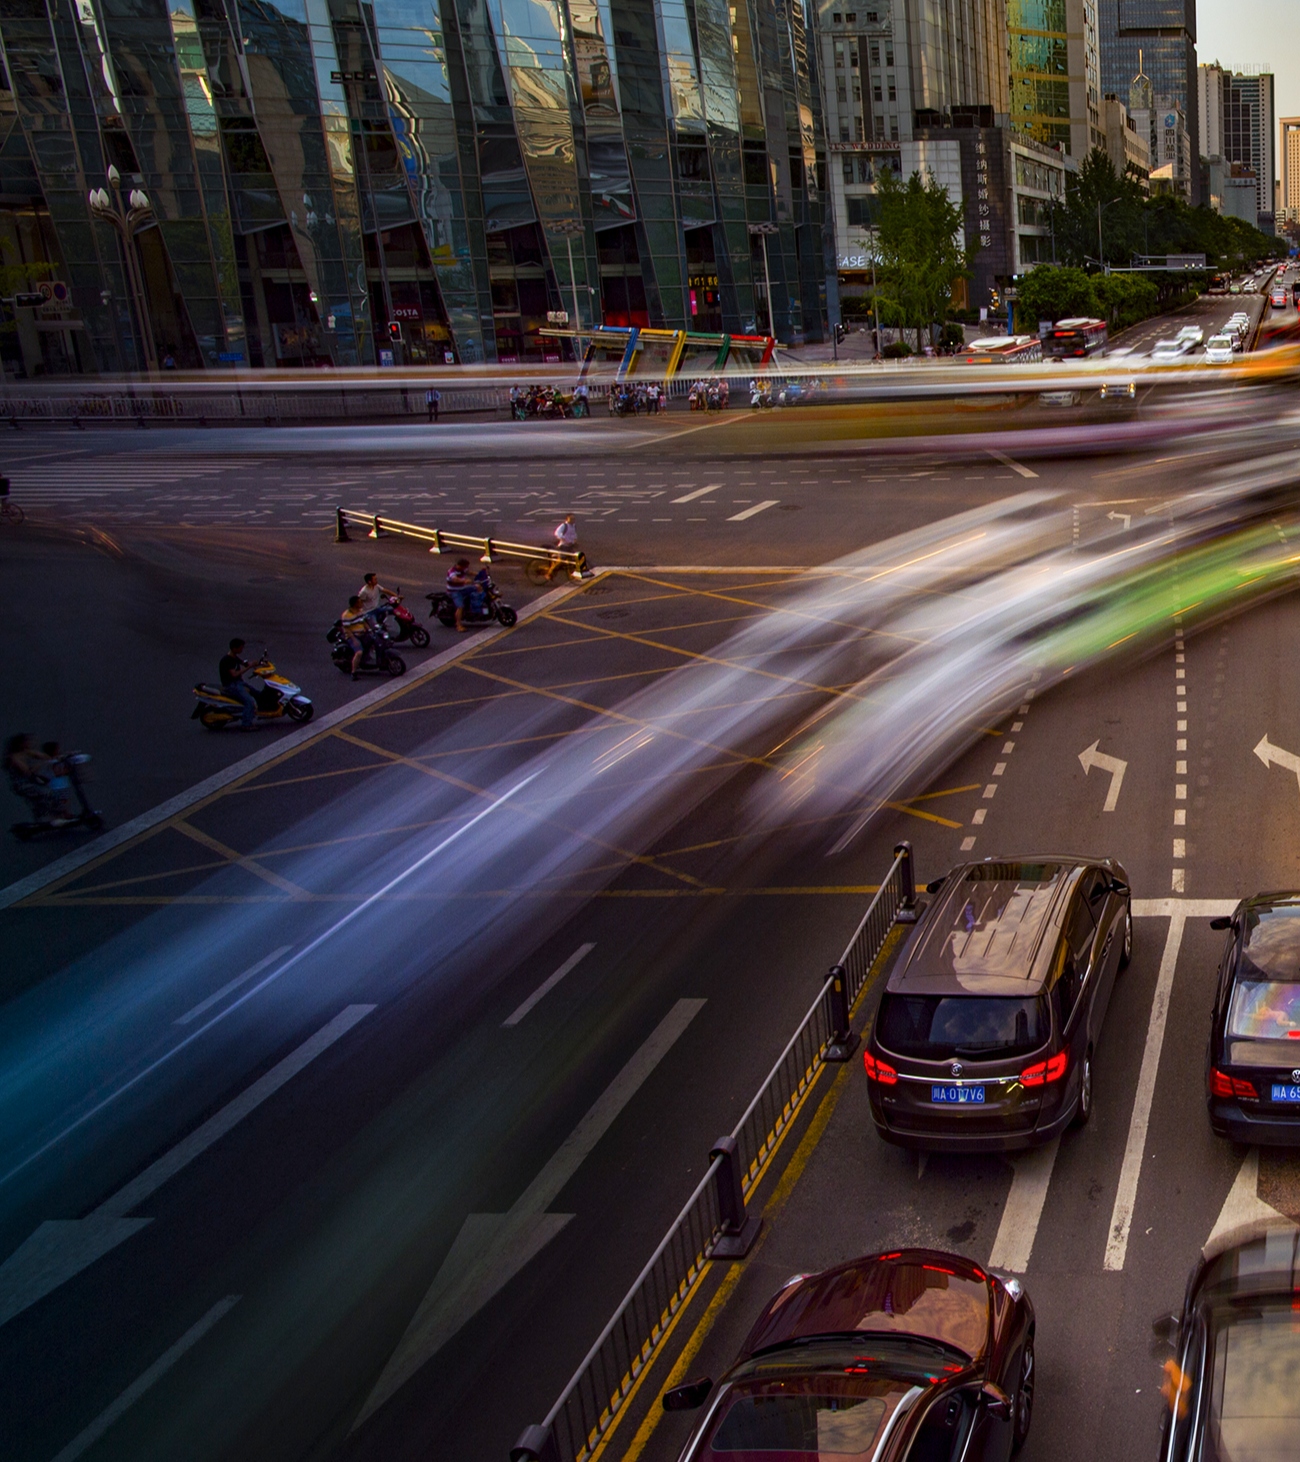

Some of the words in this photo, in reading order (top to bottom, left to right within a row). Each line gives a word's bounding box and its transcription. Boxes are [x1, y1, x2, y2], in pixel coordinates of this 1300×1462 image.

[851, 141, 901, 150] WEDDING
[974, 142, 992, 248] 维纳斯婚纱摄影
